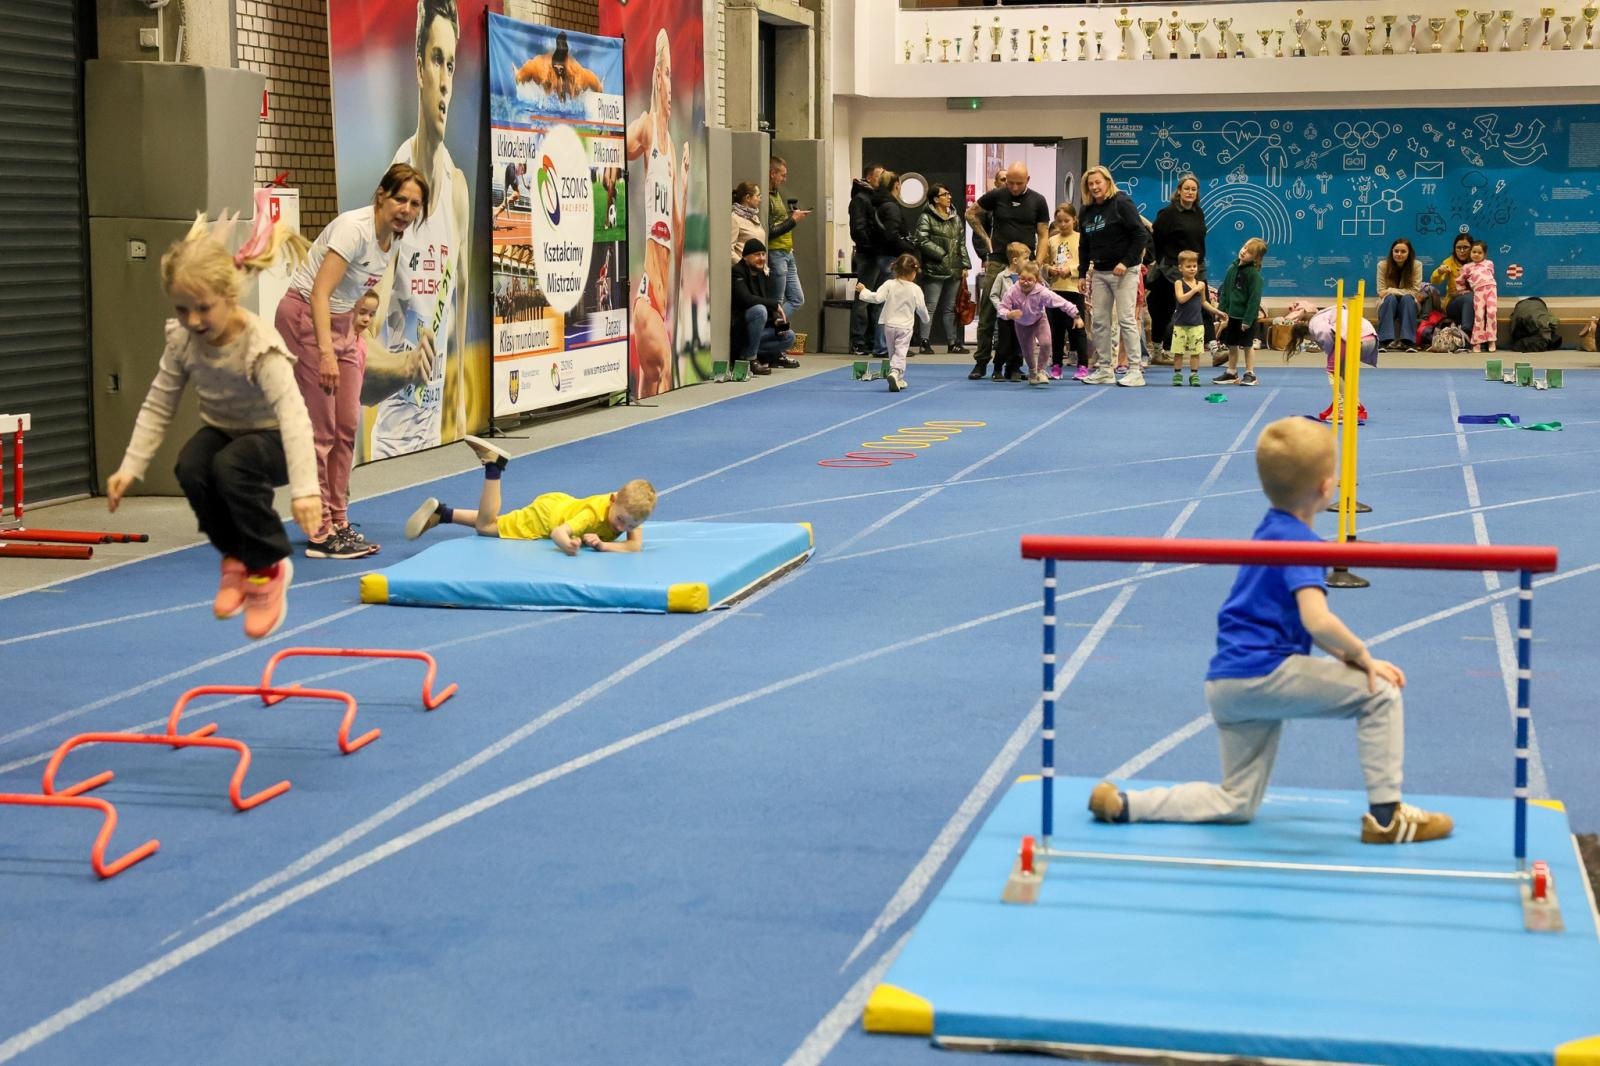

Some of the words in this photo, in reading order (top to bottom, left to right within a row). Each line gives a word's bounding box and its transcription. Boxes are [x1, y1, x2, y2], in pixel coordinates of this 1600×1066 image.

[1345, 157, 1364, 166] GO!
[561, 176, 588, 199] ZSOMS
[543, 240, 584, 267] Kształcimy
[411, 279, 441, 295] POLSK
[546, 272, 581, 293] Mistrzów
